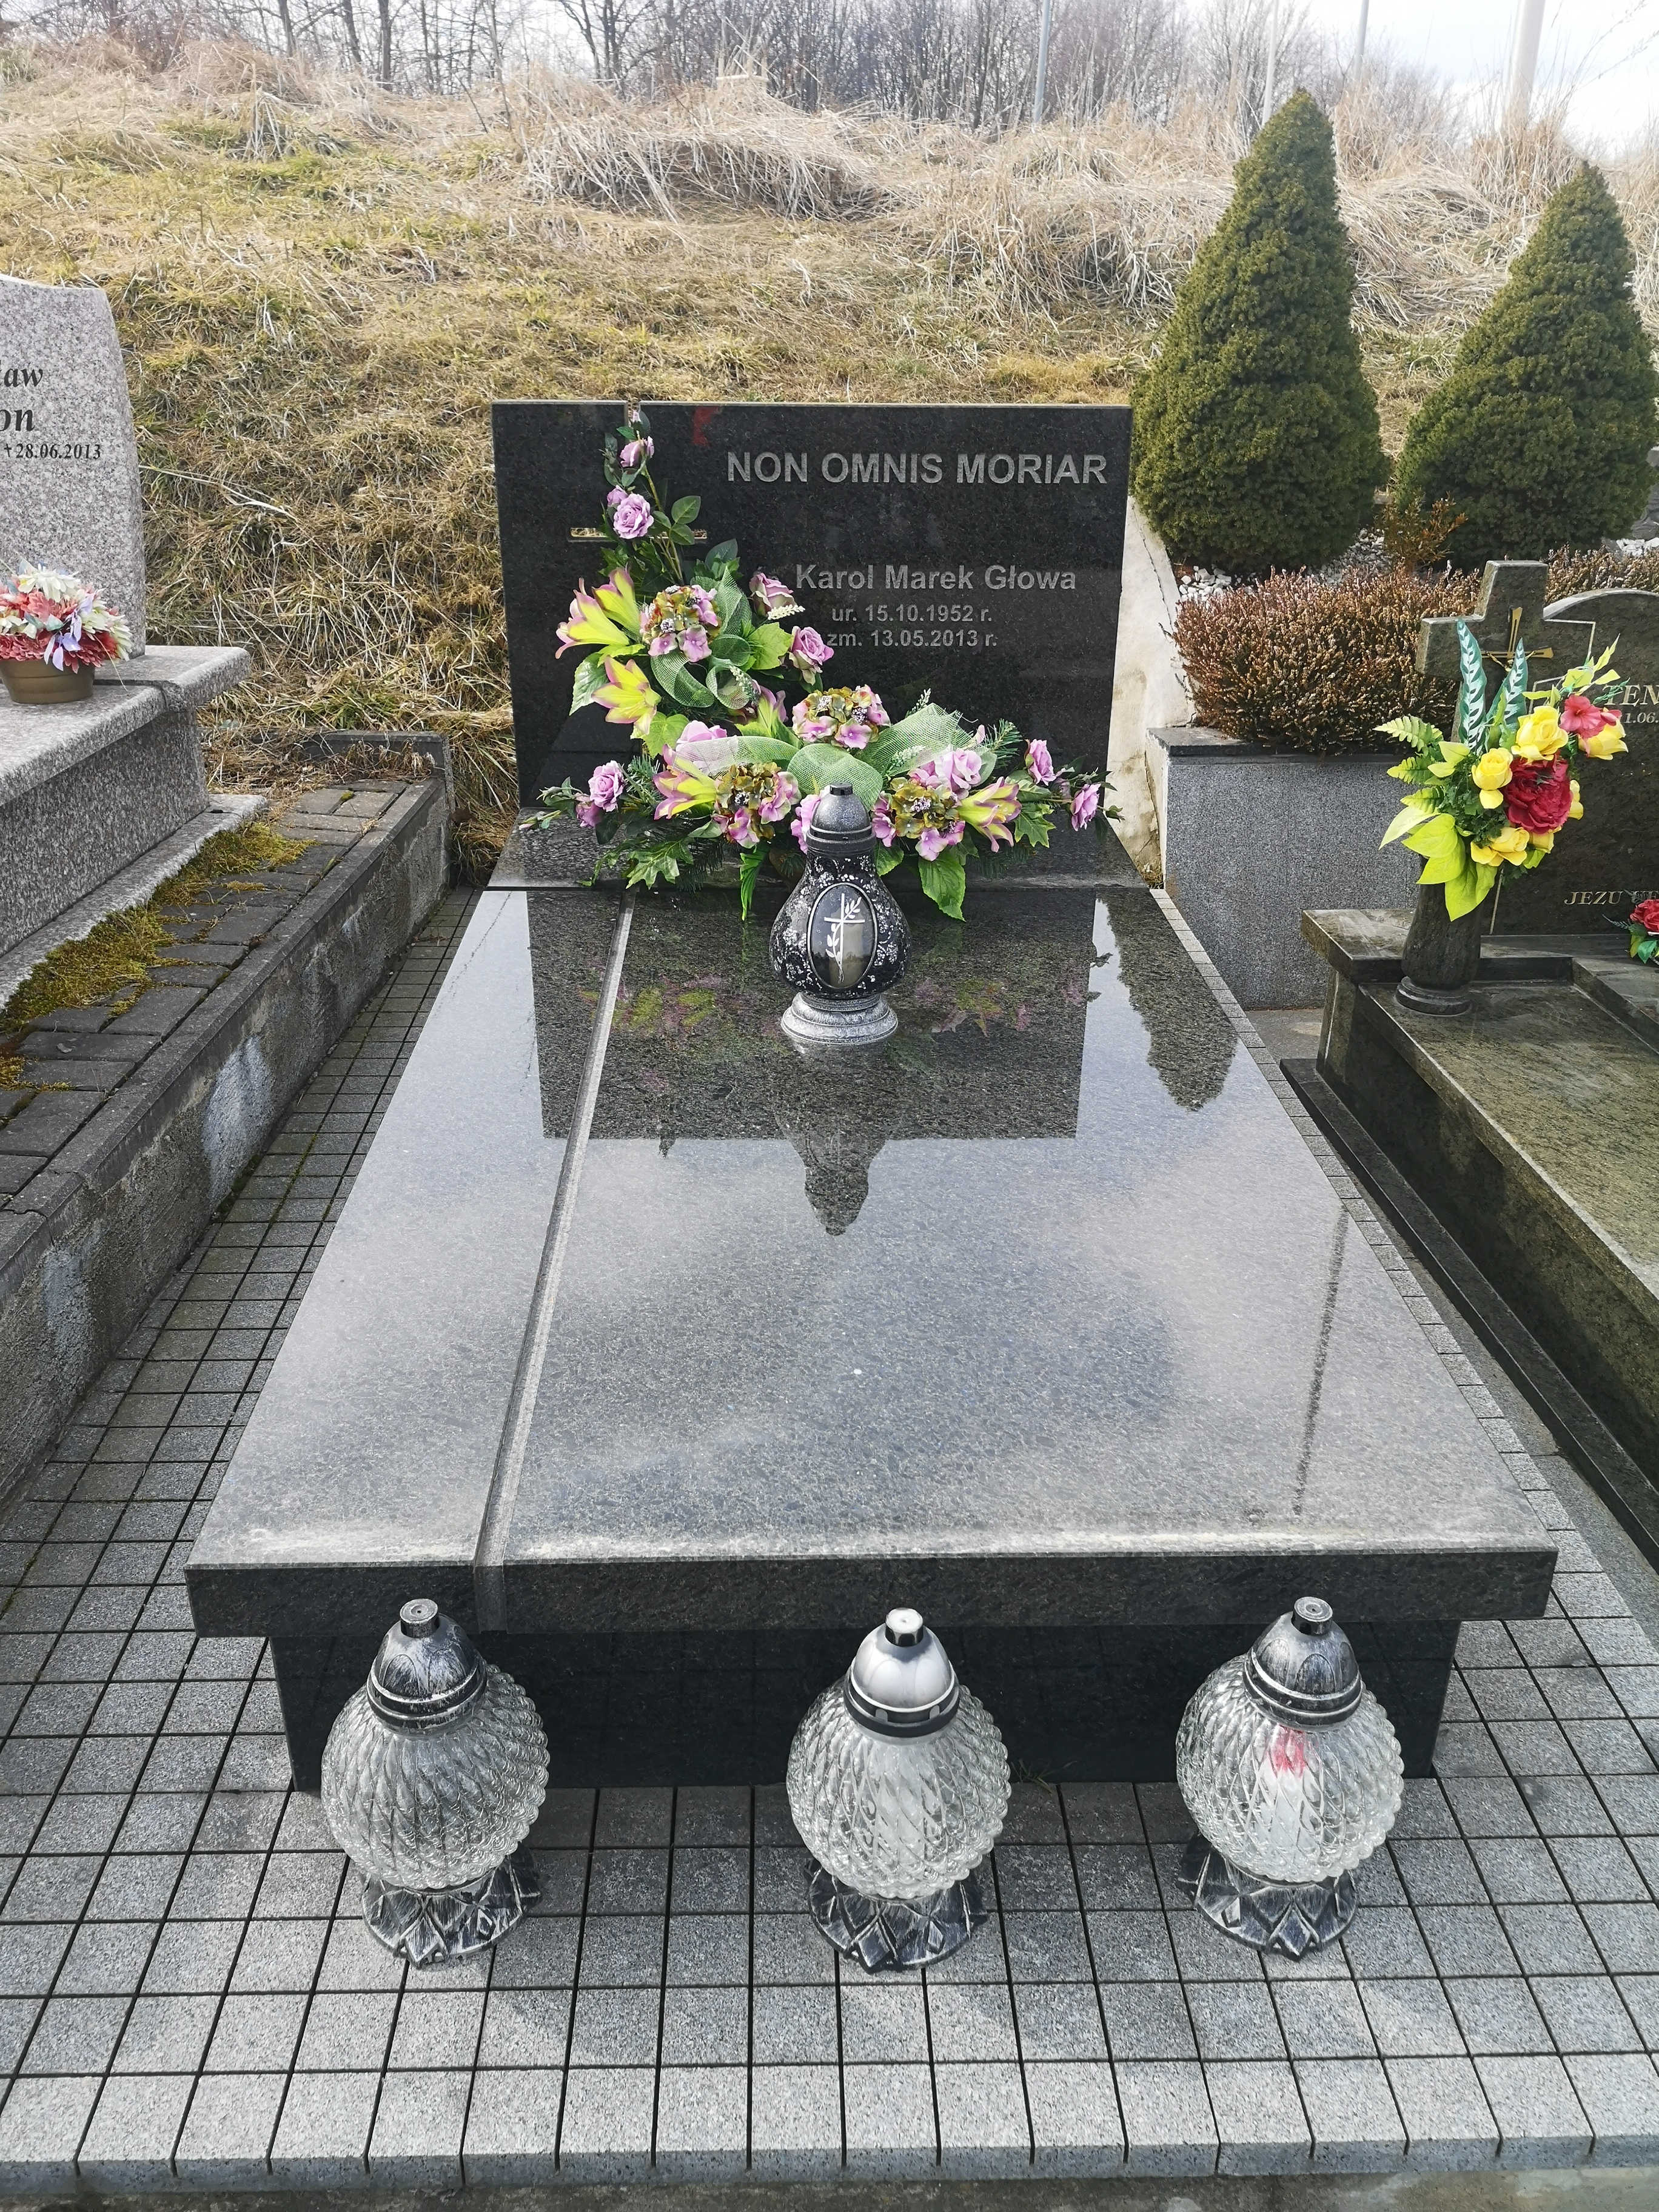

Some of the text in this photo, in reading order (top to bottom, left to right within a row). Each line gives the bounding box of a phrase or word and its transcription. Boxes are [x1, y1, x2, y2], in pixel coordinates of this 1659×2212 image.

[0, 358, 44, 387] aw
[728, 452, 1107, 484] NON OMNIS MORIAR
[796, 565, 873, 589] Karol
[885, 565, 974, 589] Marek
[985, 565, 1076, 590] Głowa
[832, 604, 992, 622] ur. 15.10.1952 r.
[826, 629, 997, 647] zm. 13.05.2013 r.
[1617, 712, 1659, 724] 1.06.
[1564, 891, 1623, 905] JEZU
